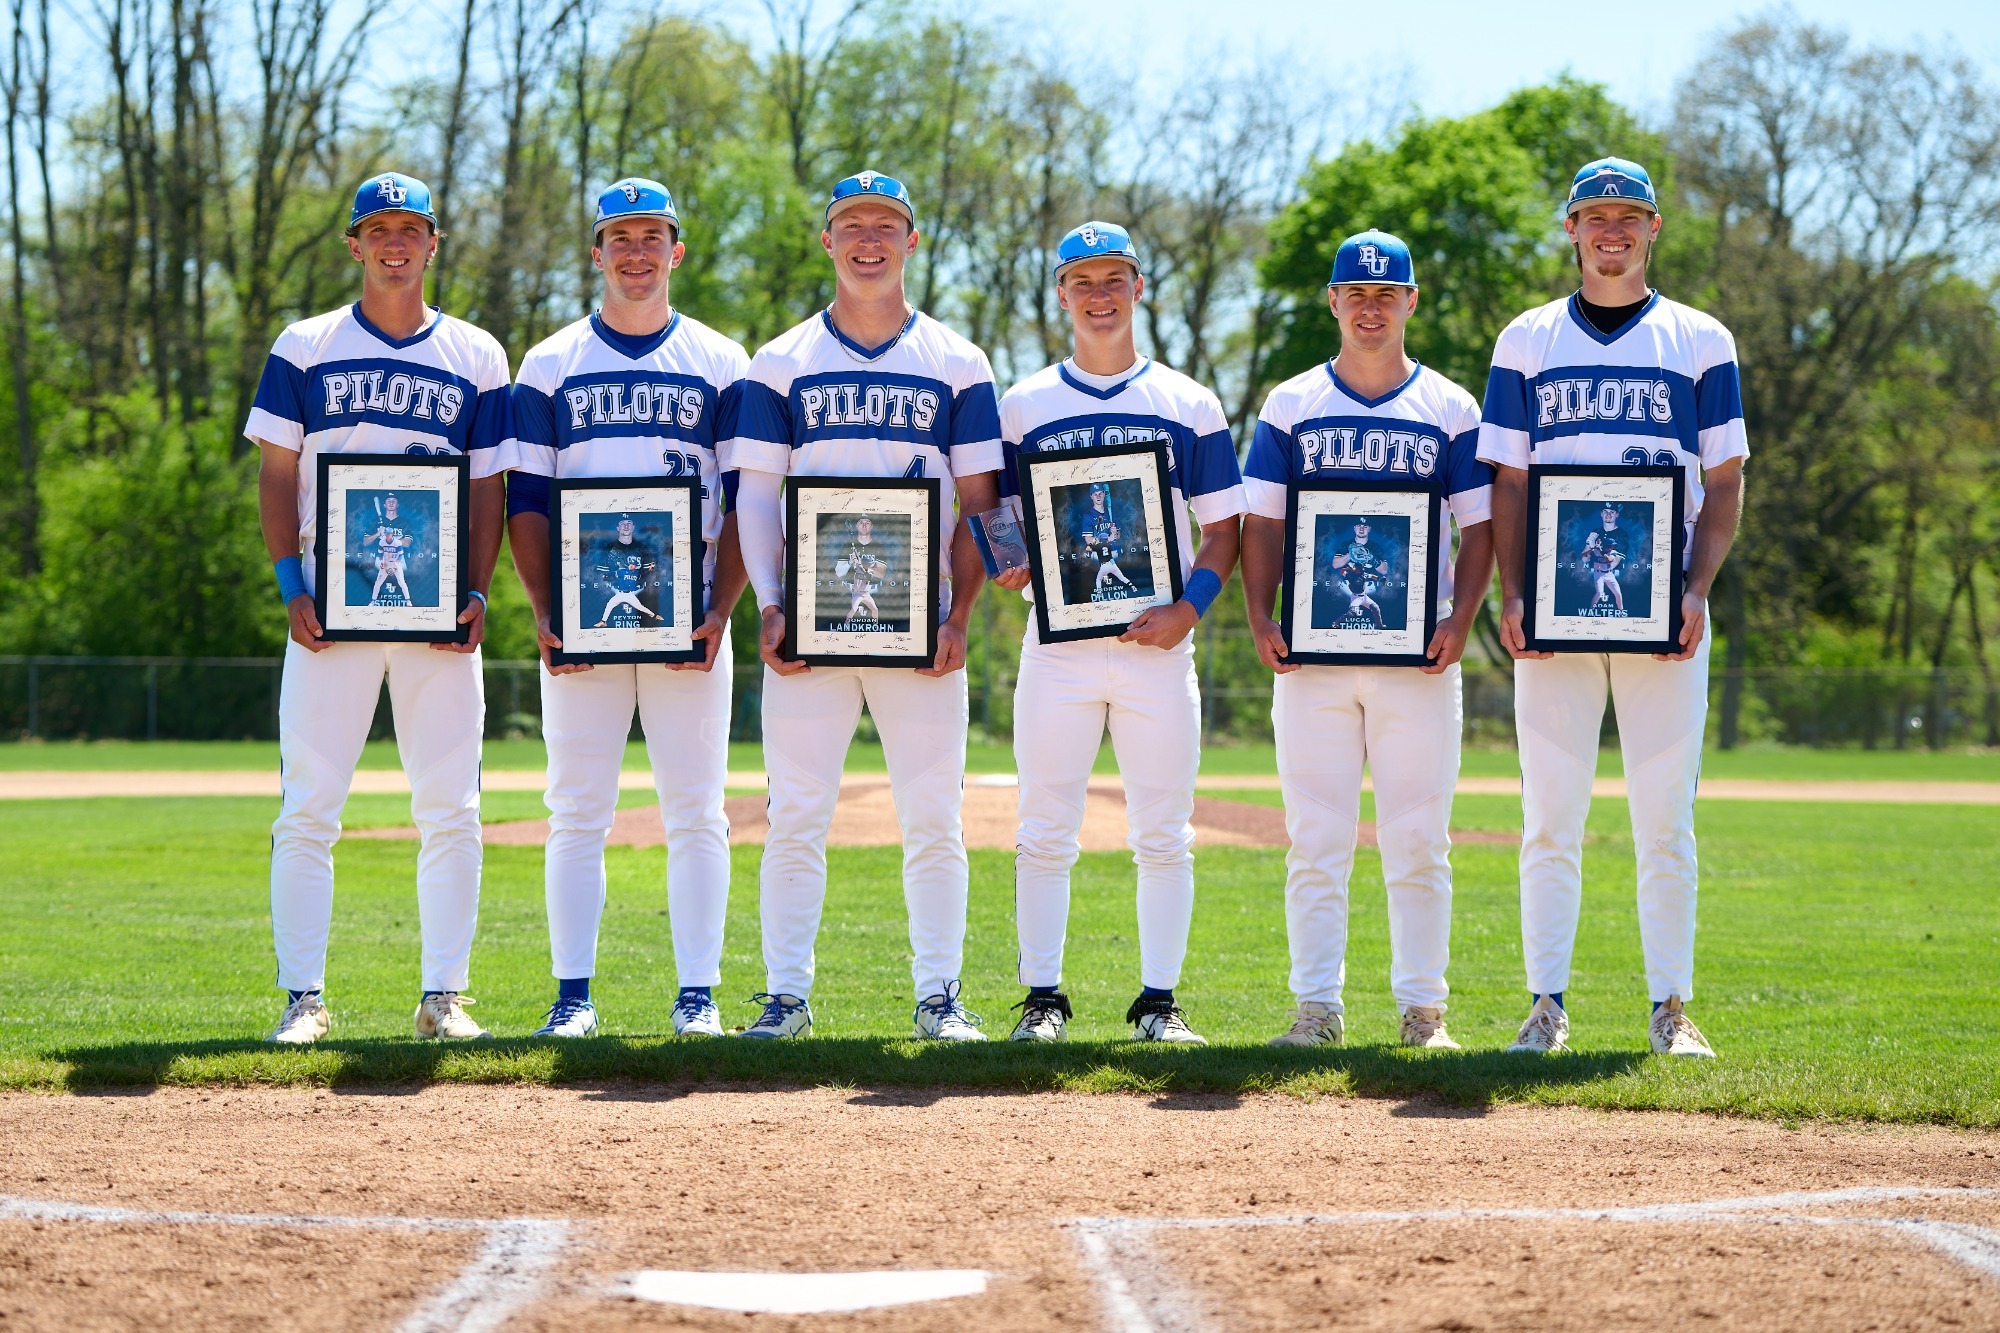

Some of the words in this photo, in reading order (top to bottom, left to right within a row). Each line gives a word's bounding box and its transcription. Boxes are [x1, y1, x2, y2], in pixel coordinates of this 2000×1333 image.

[377, 177, 407, 205] BU
[1358, 245, 1390, 277] BU
[323, 369, 464, 426] PILOTS
[564, 382, 704, 430] PILOTS
[800, 383, 939, 431] PILOTS
[1536, 378, 1673, 428] PILOTS
[1298, 427, 1439, 478] PILOTS
[1102, 547, 1109, 556] 2
[1091, 591, 1127, 602] DILLON
[1578, 608, 1628, 617] WALTERS
[830, 623, 894, 632] LANDKROHN
